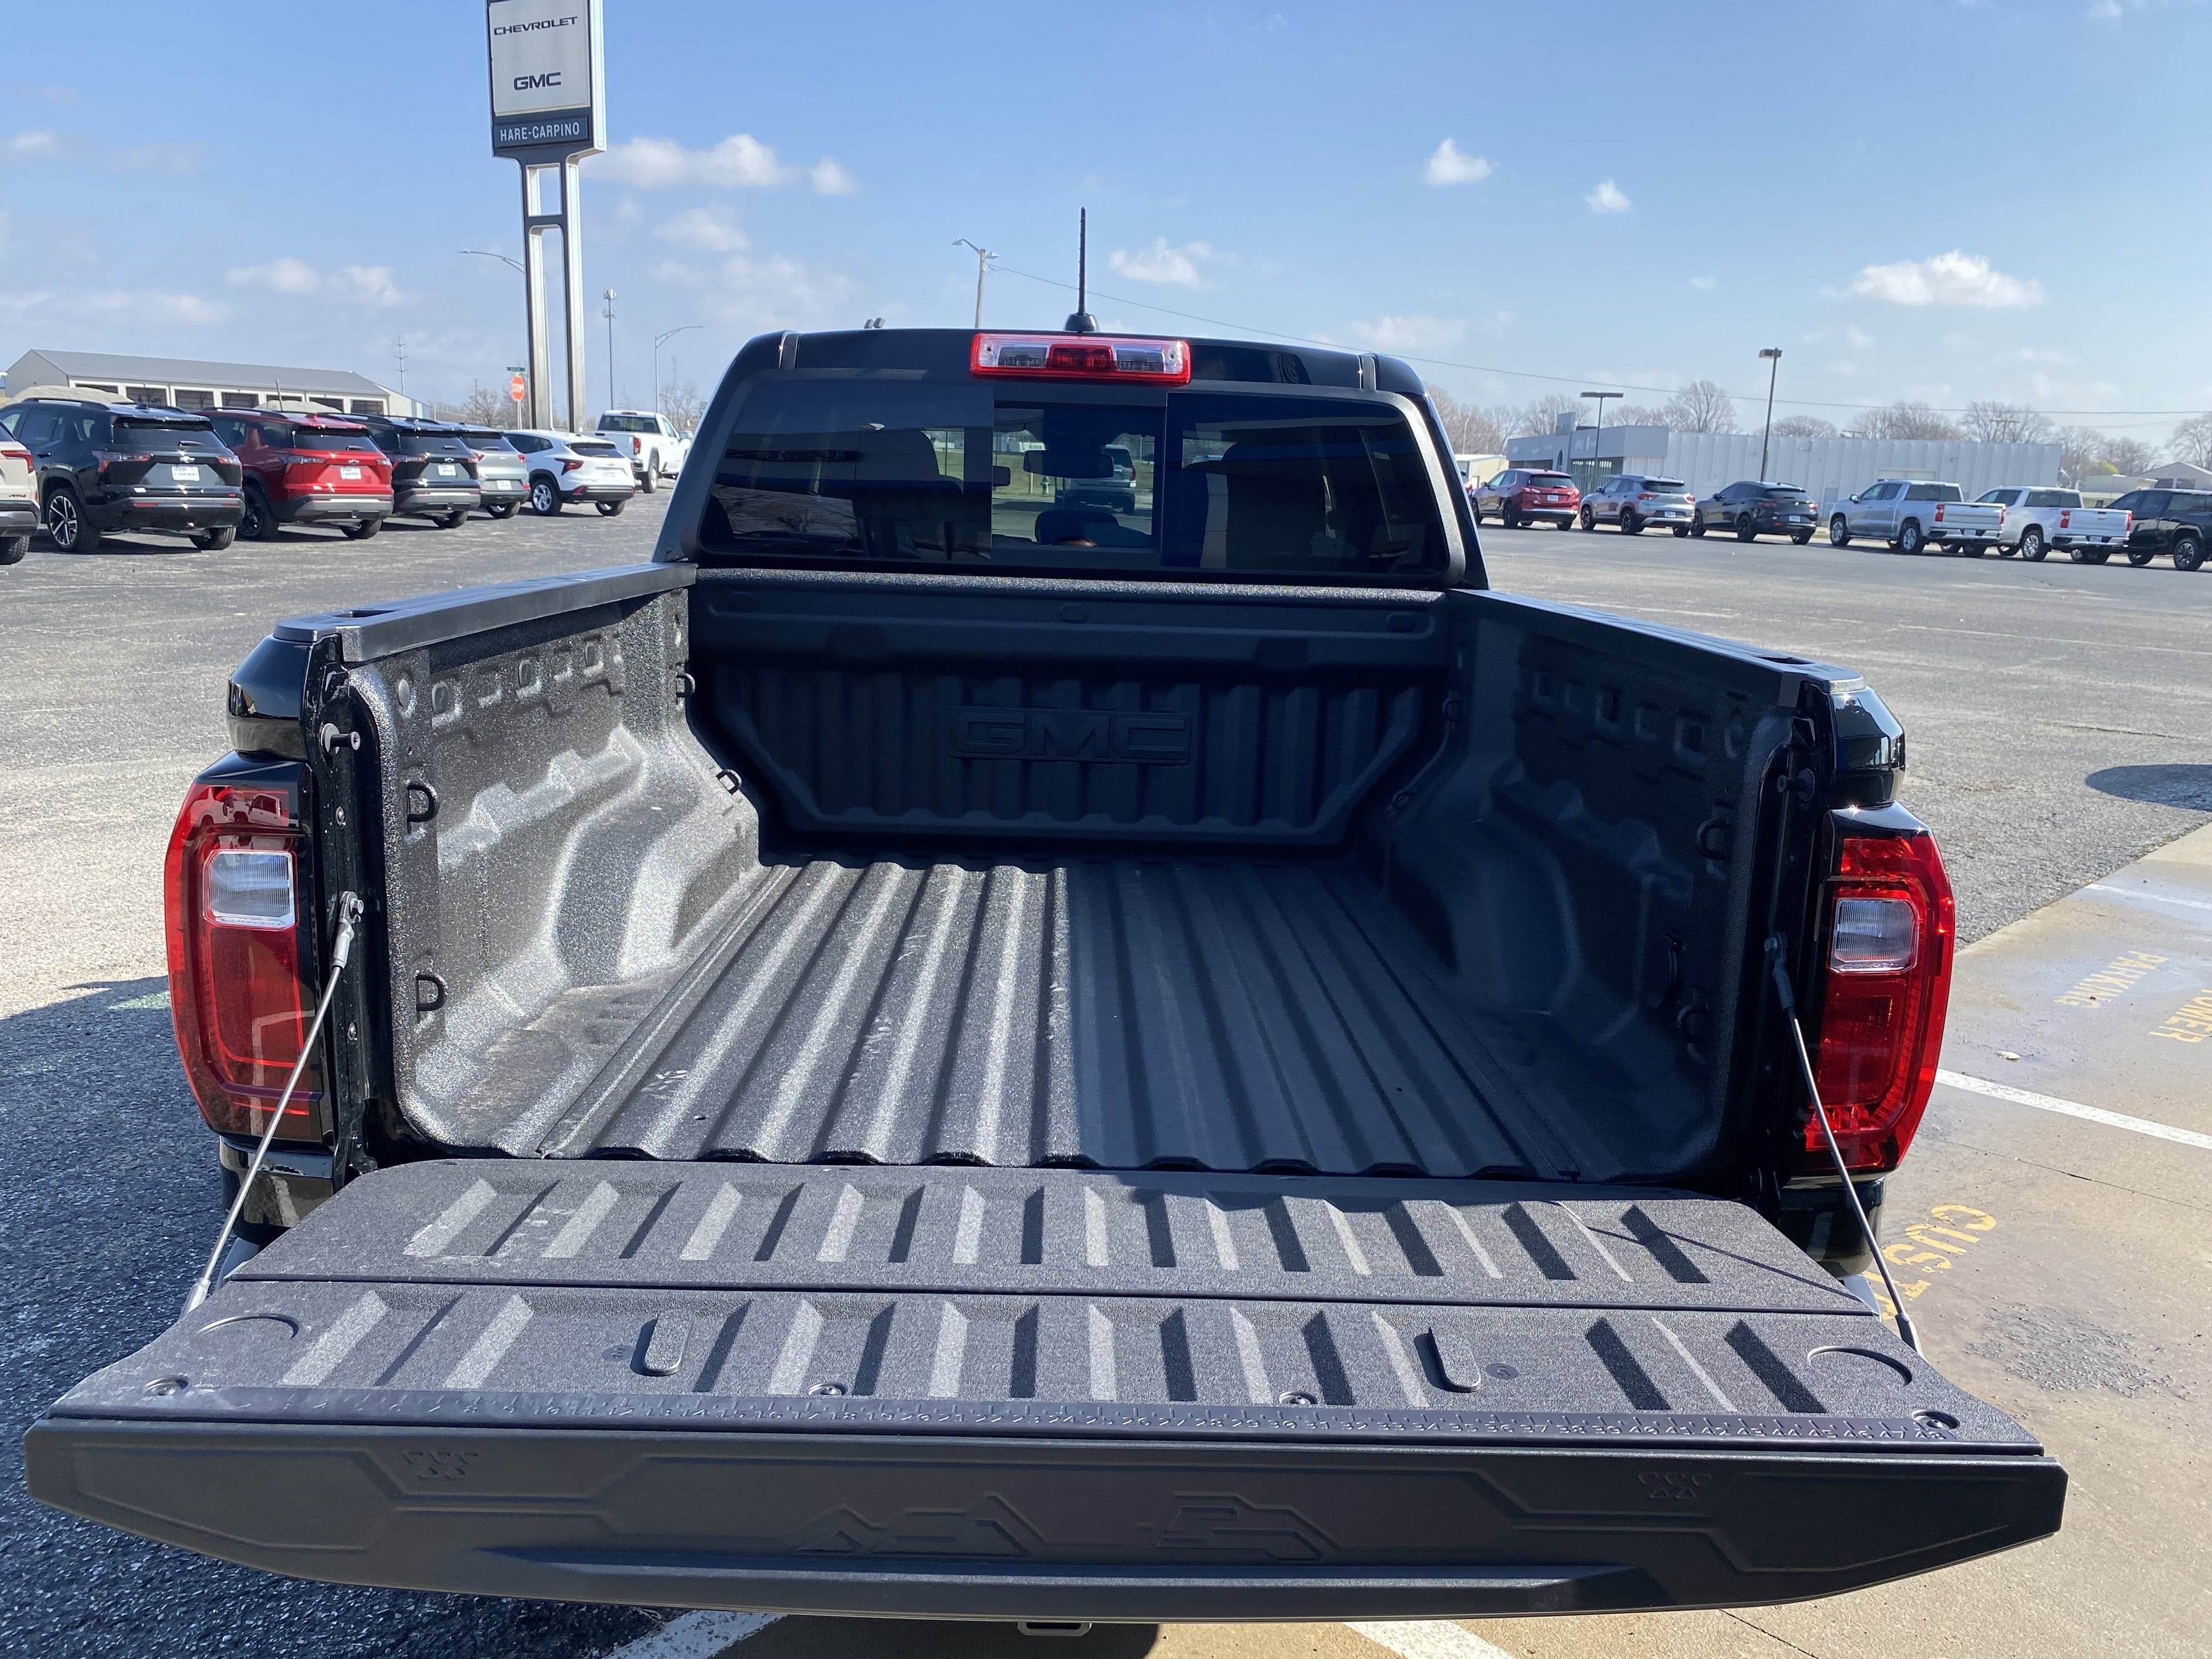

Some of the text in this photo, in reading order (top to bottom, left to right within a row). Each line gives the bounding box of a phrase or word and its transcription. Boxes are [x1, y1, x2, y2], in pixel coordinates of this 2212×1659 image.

[494, 16, 578, 35] CHEVROLET
[514, 72, 561, 91] GMC
[500, 122, 580, 142] HARE-CARPINO
[511, 383, 524, 394] STOP
[953, 714, 1187, 760] GMC
[2053, 950, 2170, 1009] PARKING
